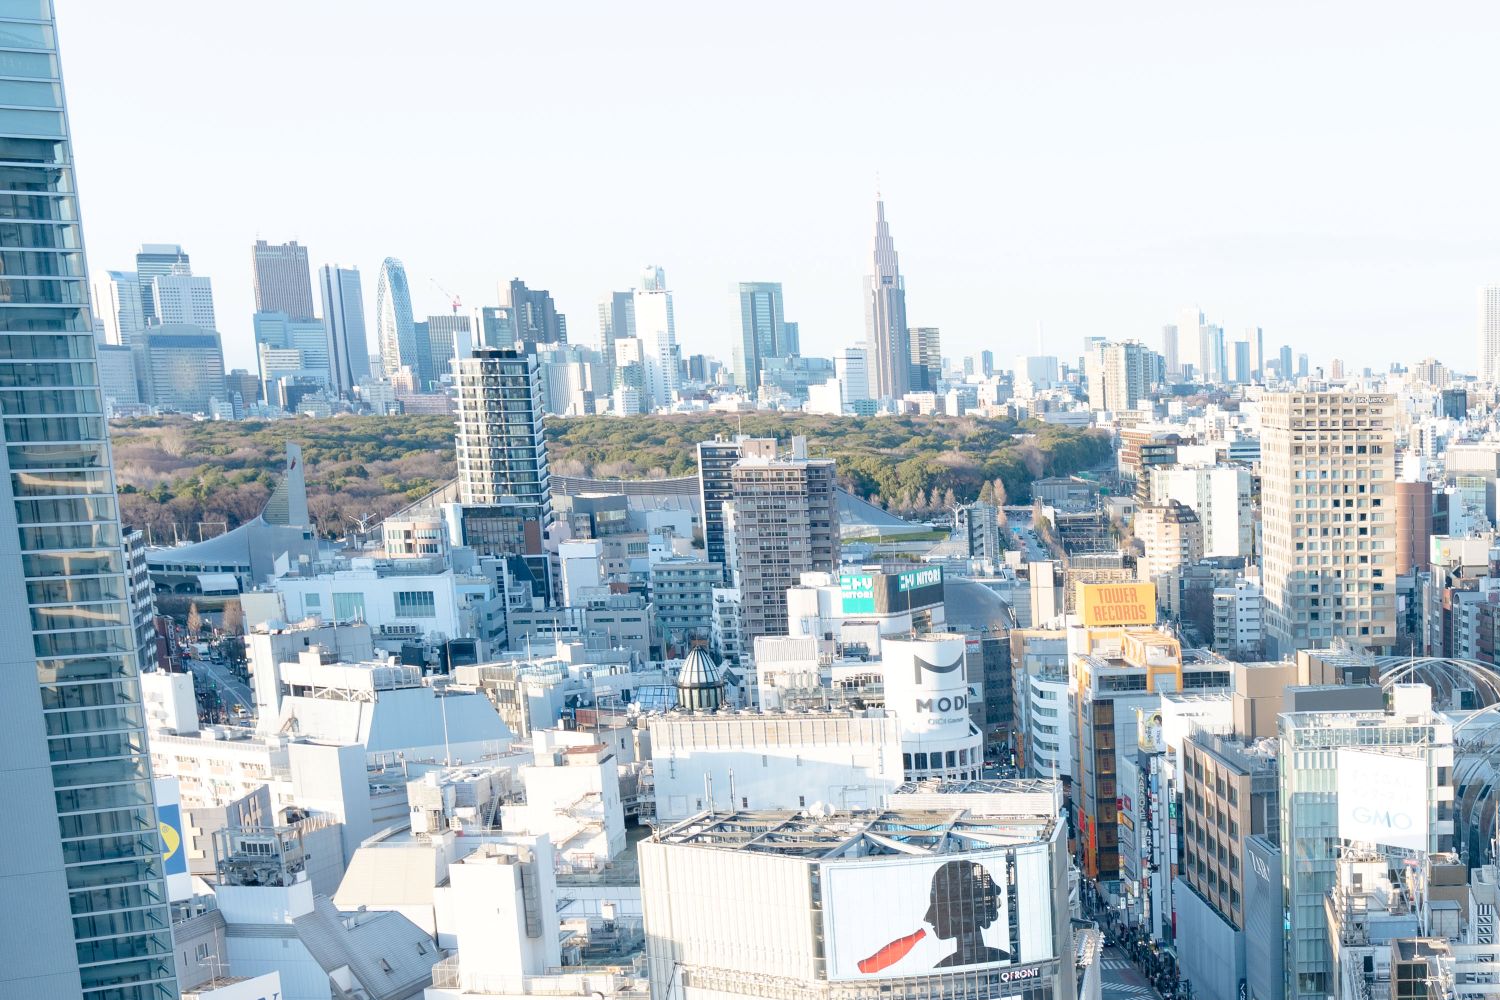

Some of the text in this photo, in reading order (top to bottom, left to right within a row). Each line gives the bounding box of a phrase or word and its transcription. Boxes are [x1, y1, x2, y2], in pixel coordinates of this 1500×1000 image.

[841, 577, 873, 590] ニトリ
[1097, 587, 1138, 604] TOWER
[1093, 604, 1147, 622] RECORDS
[916, 695, 968, 713] MODI
[1352, 806, 1412, 830] GMO
[1001, 968, 1039, 983] QFRONT
